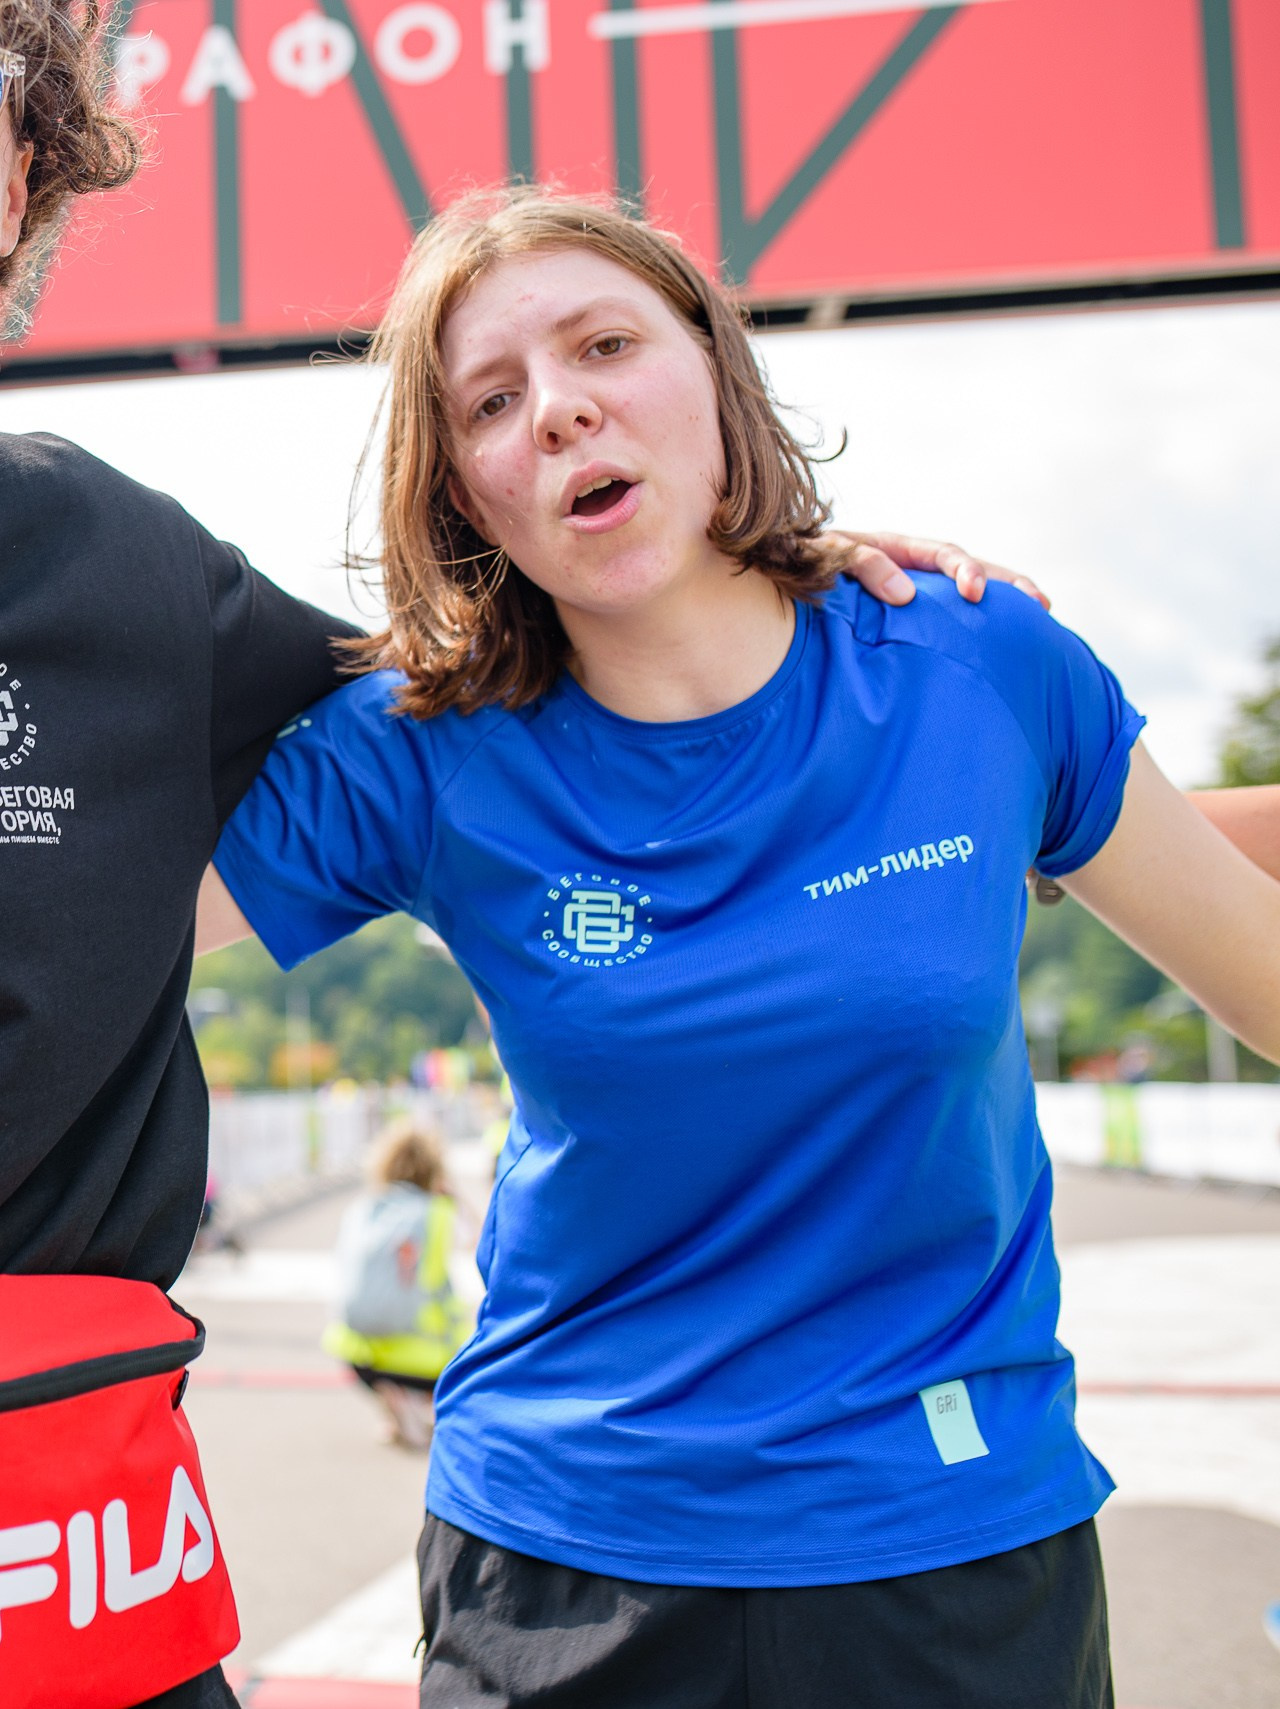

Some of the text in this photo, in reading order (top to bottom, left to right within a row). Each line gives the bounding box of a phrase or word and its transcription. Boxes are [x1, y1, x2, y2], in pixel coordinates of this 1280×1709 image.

[114, 0, 550, 108] РАФОН
[11, 835, 36, 845] ПИШЕМ
[803, 834, 974, 900] тим-лидер
[547, 873, 651, 907] БЕГОВОЕ
[542, 929, 653, 968] СООБЩЕСТВО
